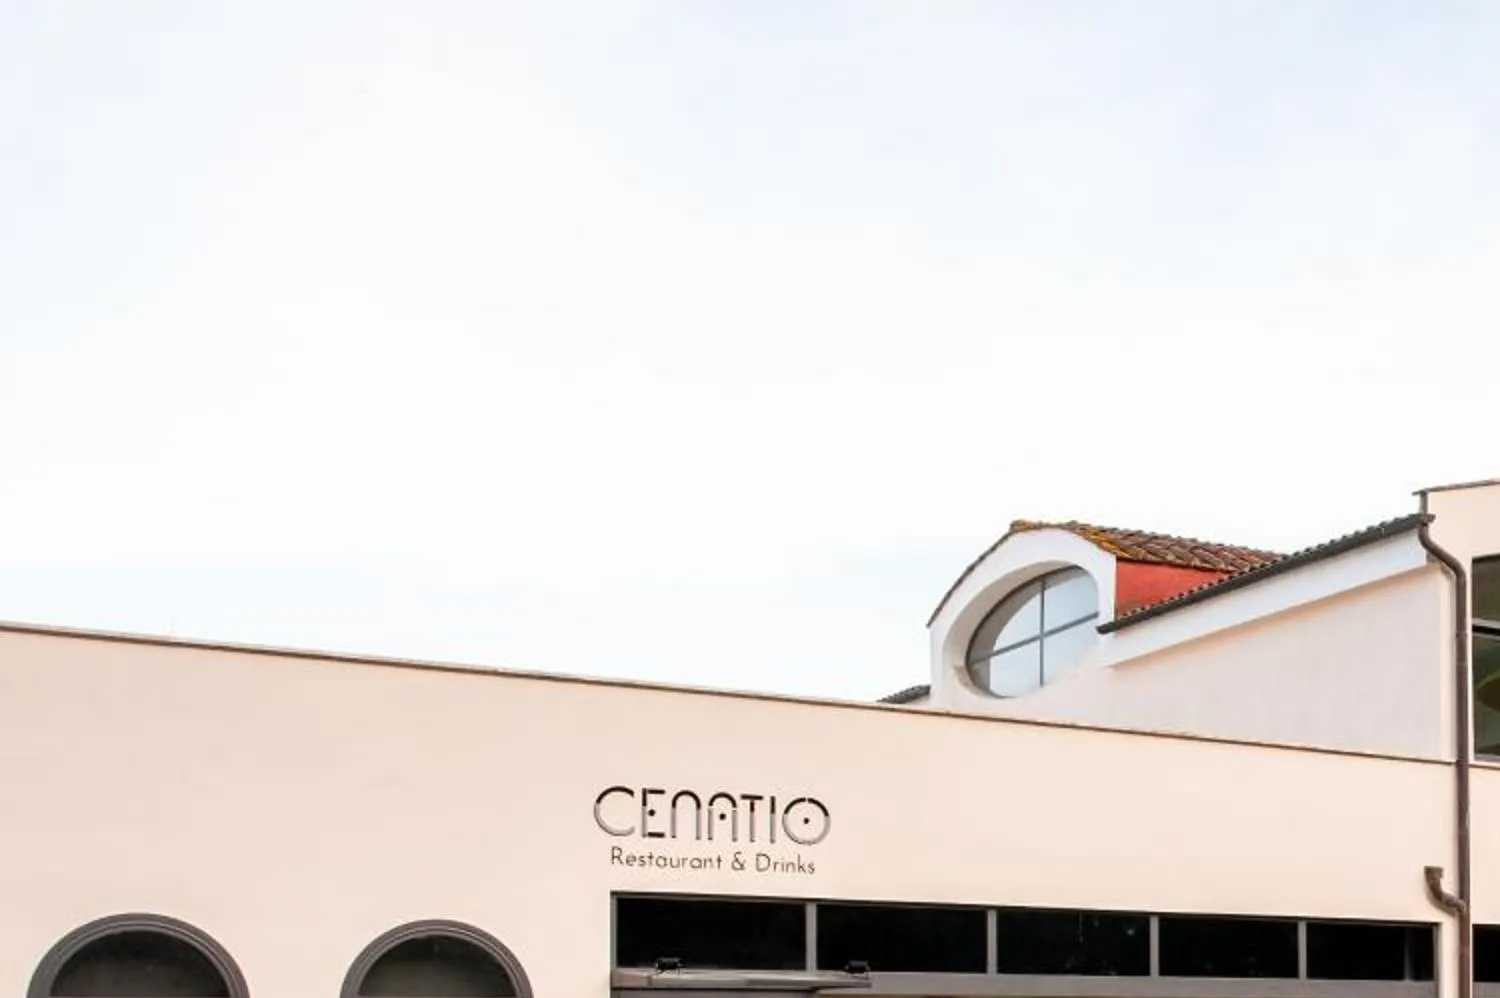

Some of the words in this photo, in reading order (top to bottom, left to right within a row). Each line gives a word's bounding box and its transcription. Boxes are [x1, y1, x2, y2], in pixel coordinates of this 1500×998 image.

[594, 786, 830, 845] CENATIO
[610, 846, 722, 870] Restaurant
[731, 851, 746, 872] &
[755, 853, 815, 875] Drinks
